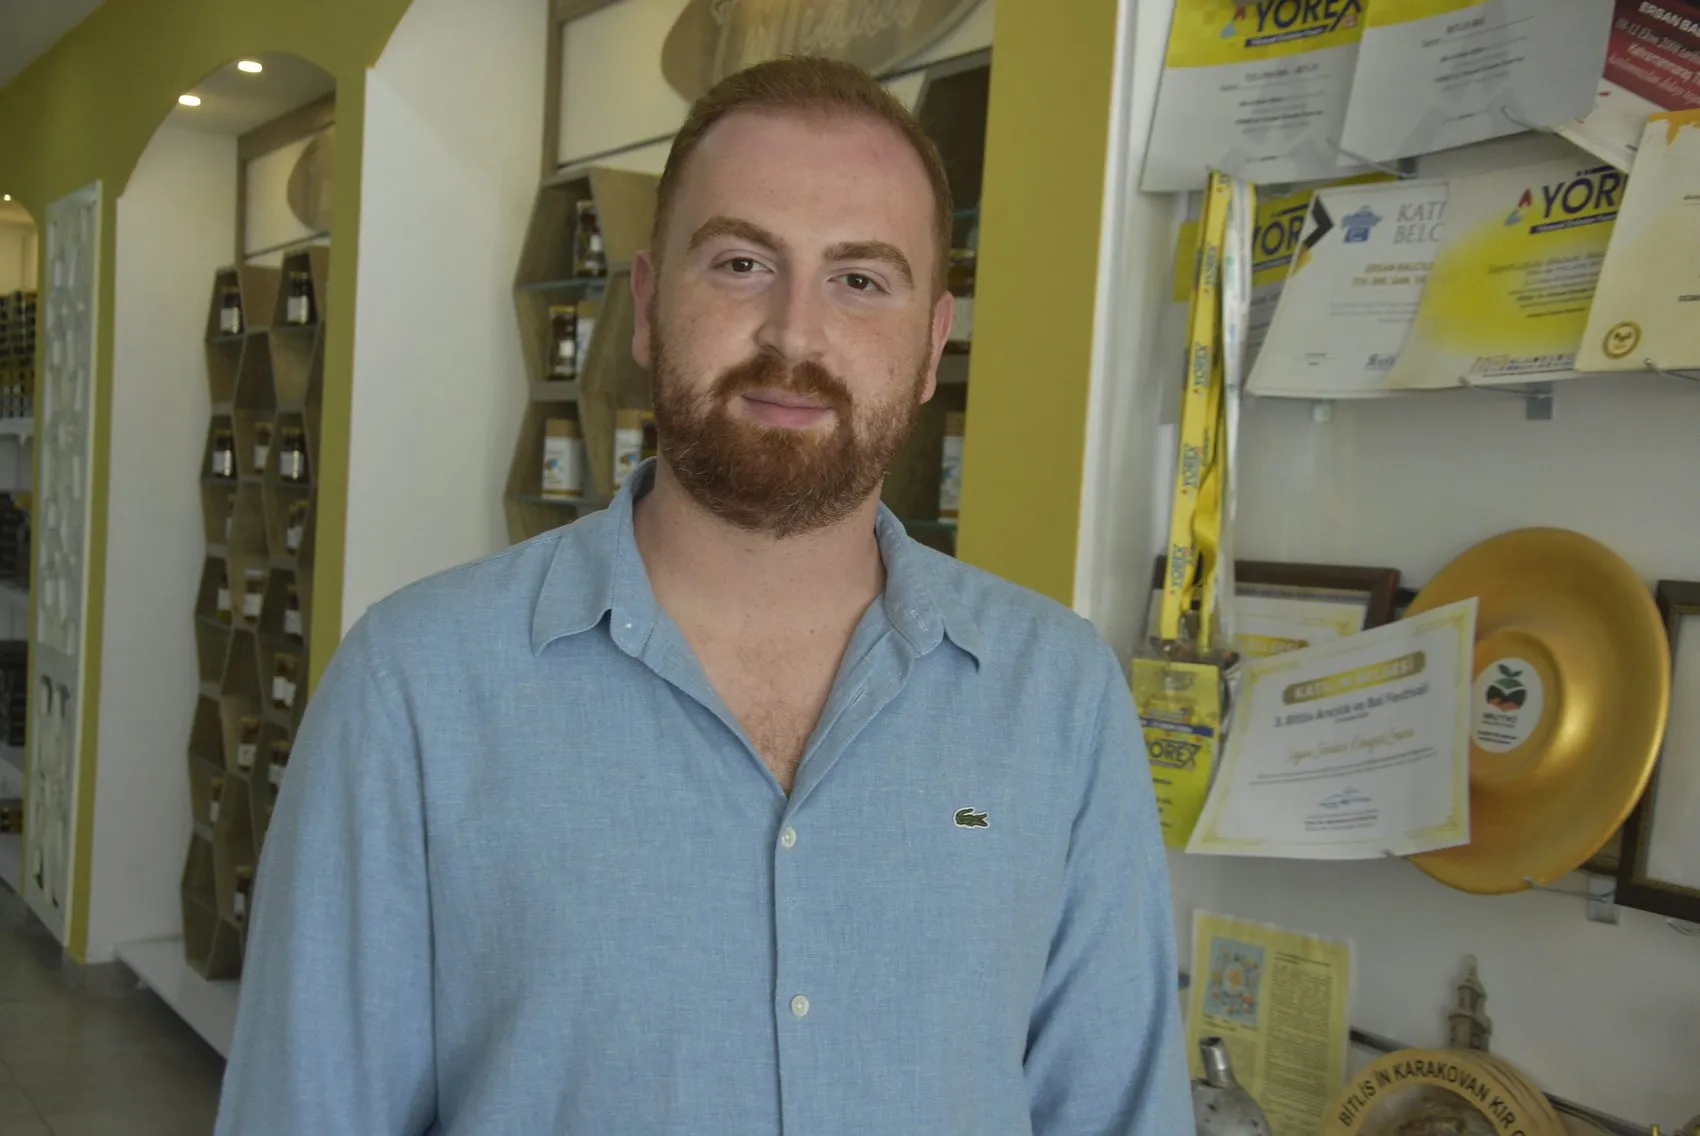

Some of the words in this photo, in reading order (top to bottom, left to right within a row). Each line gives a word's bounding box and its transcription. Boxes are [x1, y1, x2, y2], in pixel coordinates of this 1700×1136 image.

[1679, 18, 1700, 38] BA
[1541, 170, 1628, 218] YÖR
[1392, 1060, 1491, 1102] KARAKOVAN
